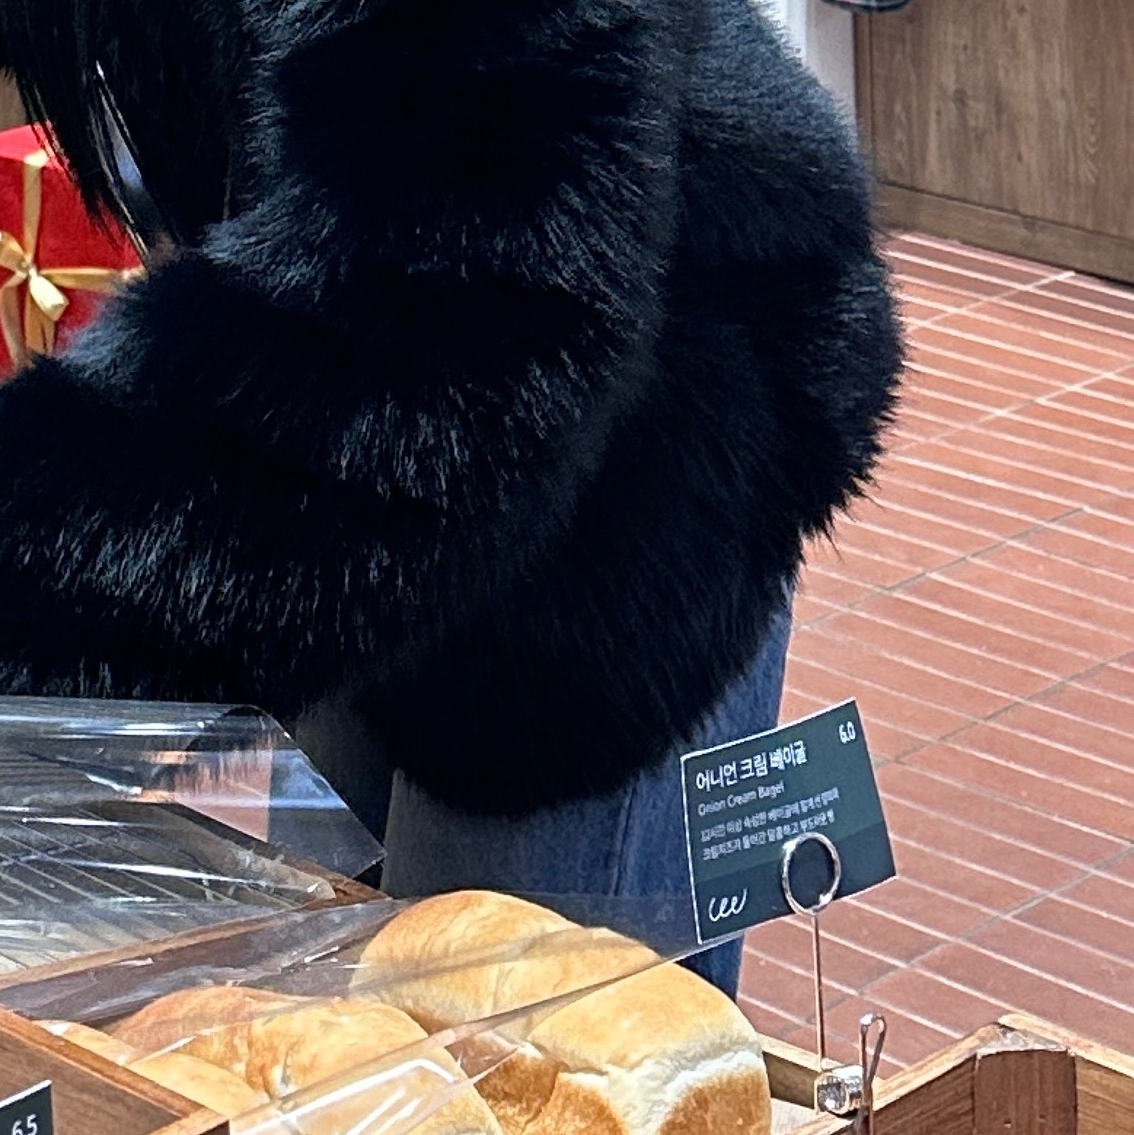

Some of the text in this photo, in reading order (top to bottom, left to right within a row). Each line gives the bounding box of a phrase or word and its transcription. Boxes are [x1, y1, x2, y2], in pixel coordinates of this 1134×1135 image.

[696, 740, 808, 792] 어니언 크림 베이글
[698, 779, 785, 817] Onion Cream Bagel
